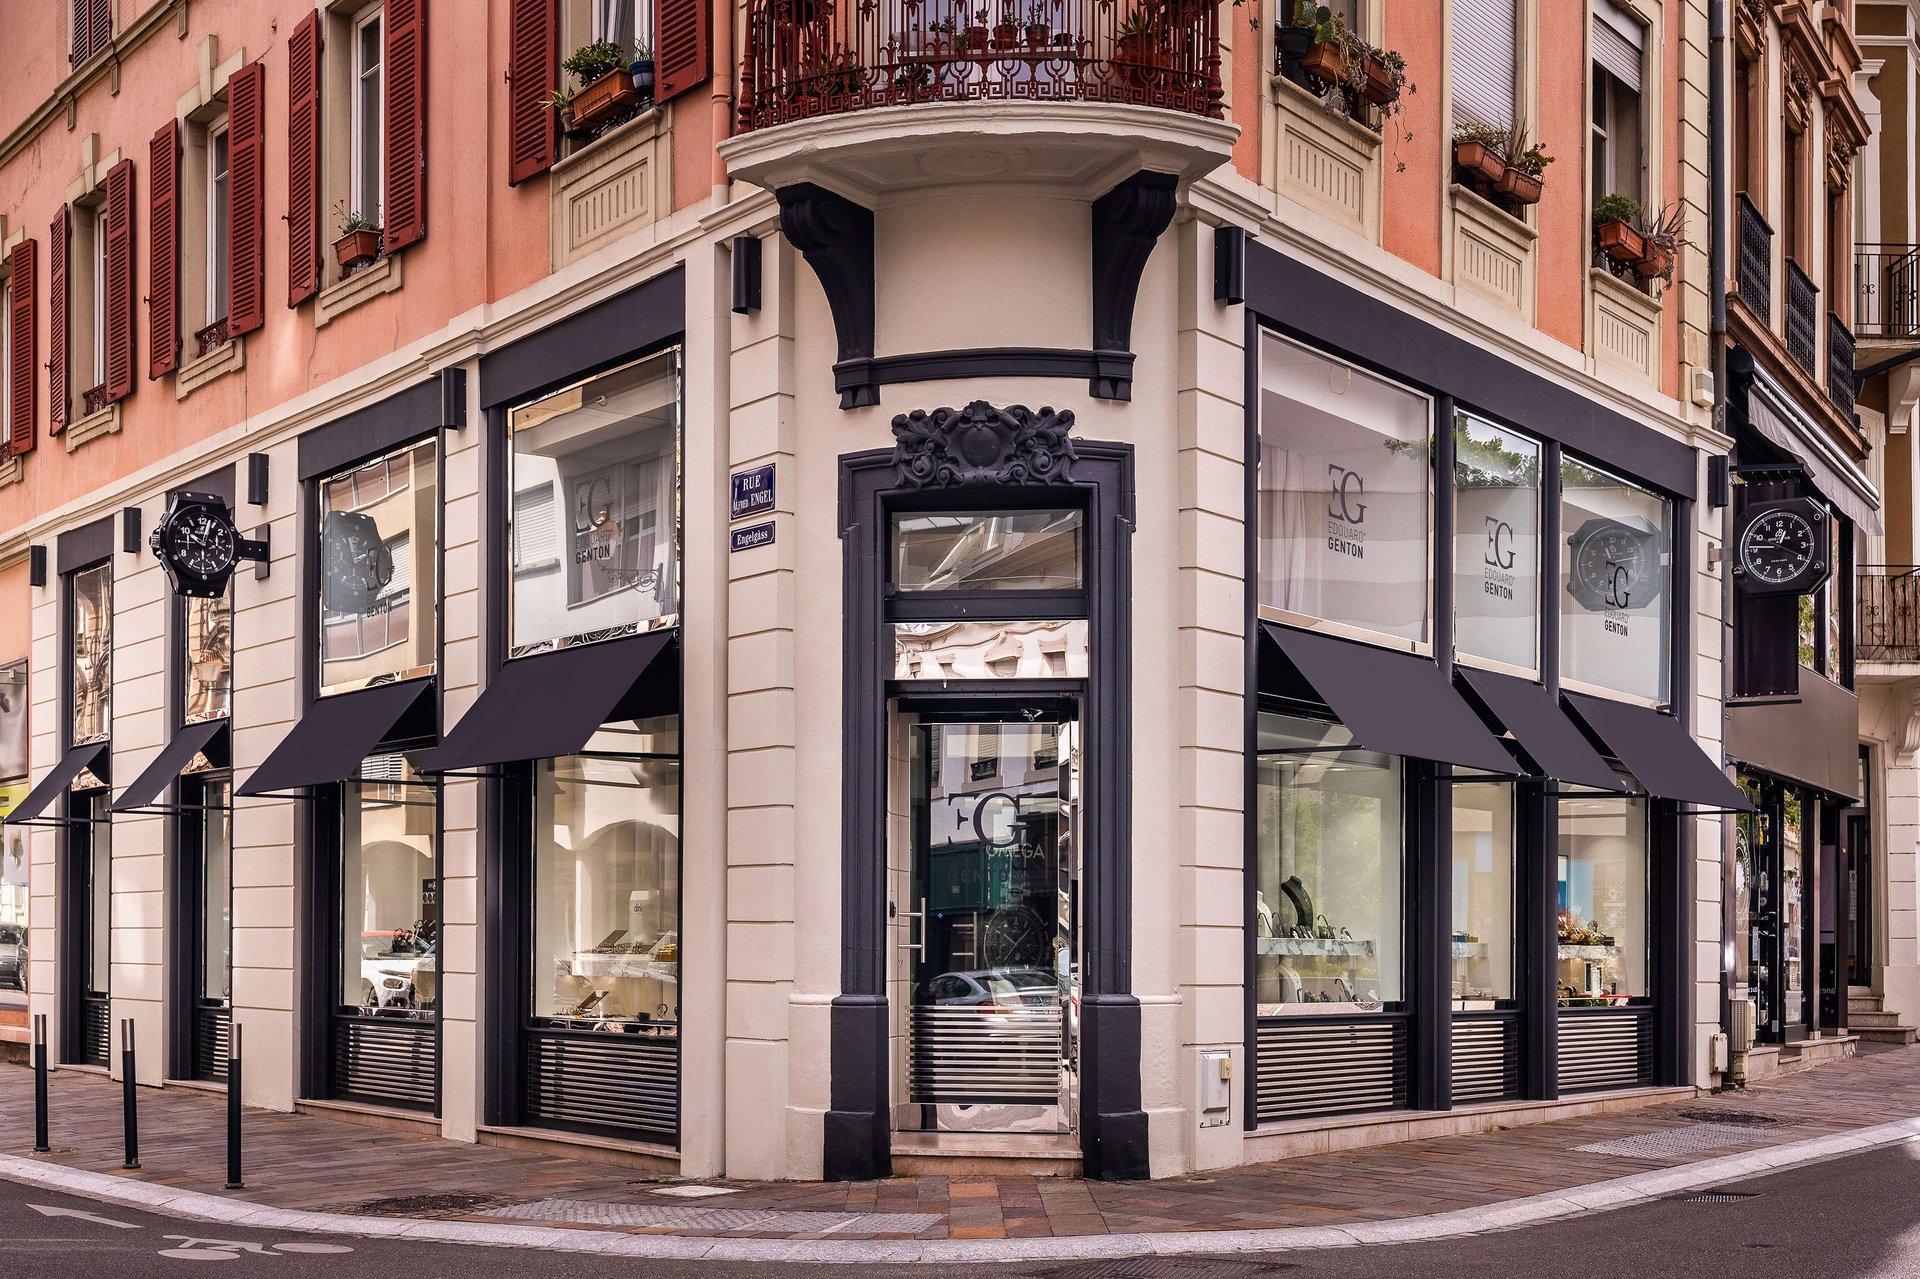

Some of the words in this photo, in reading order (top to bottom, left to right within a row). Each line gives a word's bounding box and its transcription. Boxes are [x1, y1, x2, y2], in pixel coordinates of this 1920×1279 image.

[743, 474, 761, 491] RUE
[733, 498, 749, 511] ALFRED
[750, 489, 773, 507] ENGEL
[1328, 463, 1368, 524] EG
[575, 476, 614, 533] EG
[180, 526, 190, 535] 10
[197, 517, 207, 525] 12
[217, 528, 223, 536] 2
[1328, 521, 1364, 543] EDOUARD
[1328, 536, 1364, 559] GENTON
[1484, 515, 1516, 570] EG
[180, 549, 187, 557] 8
[219, 553, 225, 561] 4
[575, 543, 610, 564] GENTON
[1484, 567, 1513, 586] EDOUARD
[1605, 560, 1631, 609] EG
[1484, 581, 1513, 601] GENTON
[1604, 619, 1628, 637] GENTON
[985, 842, 1046, 859] OMEGA
